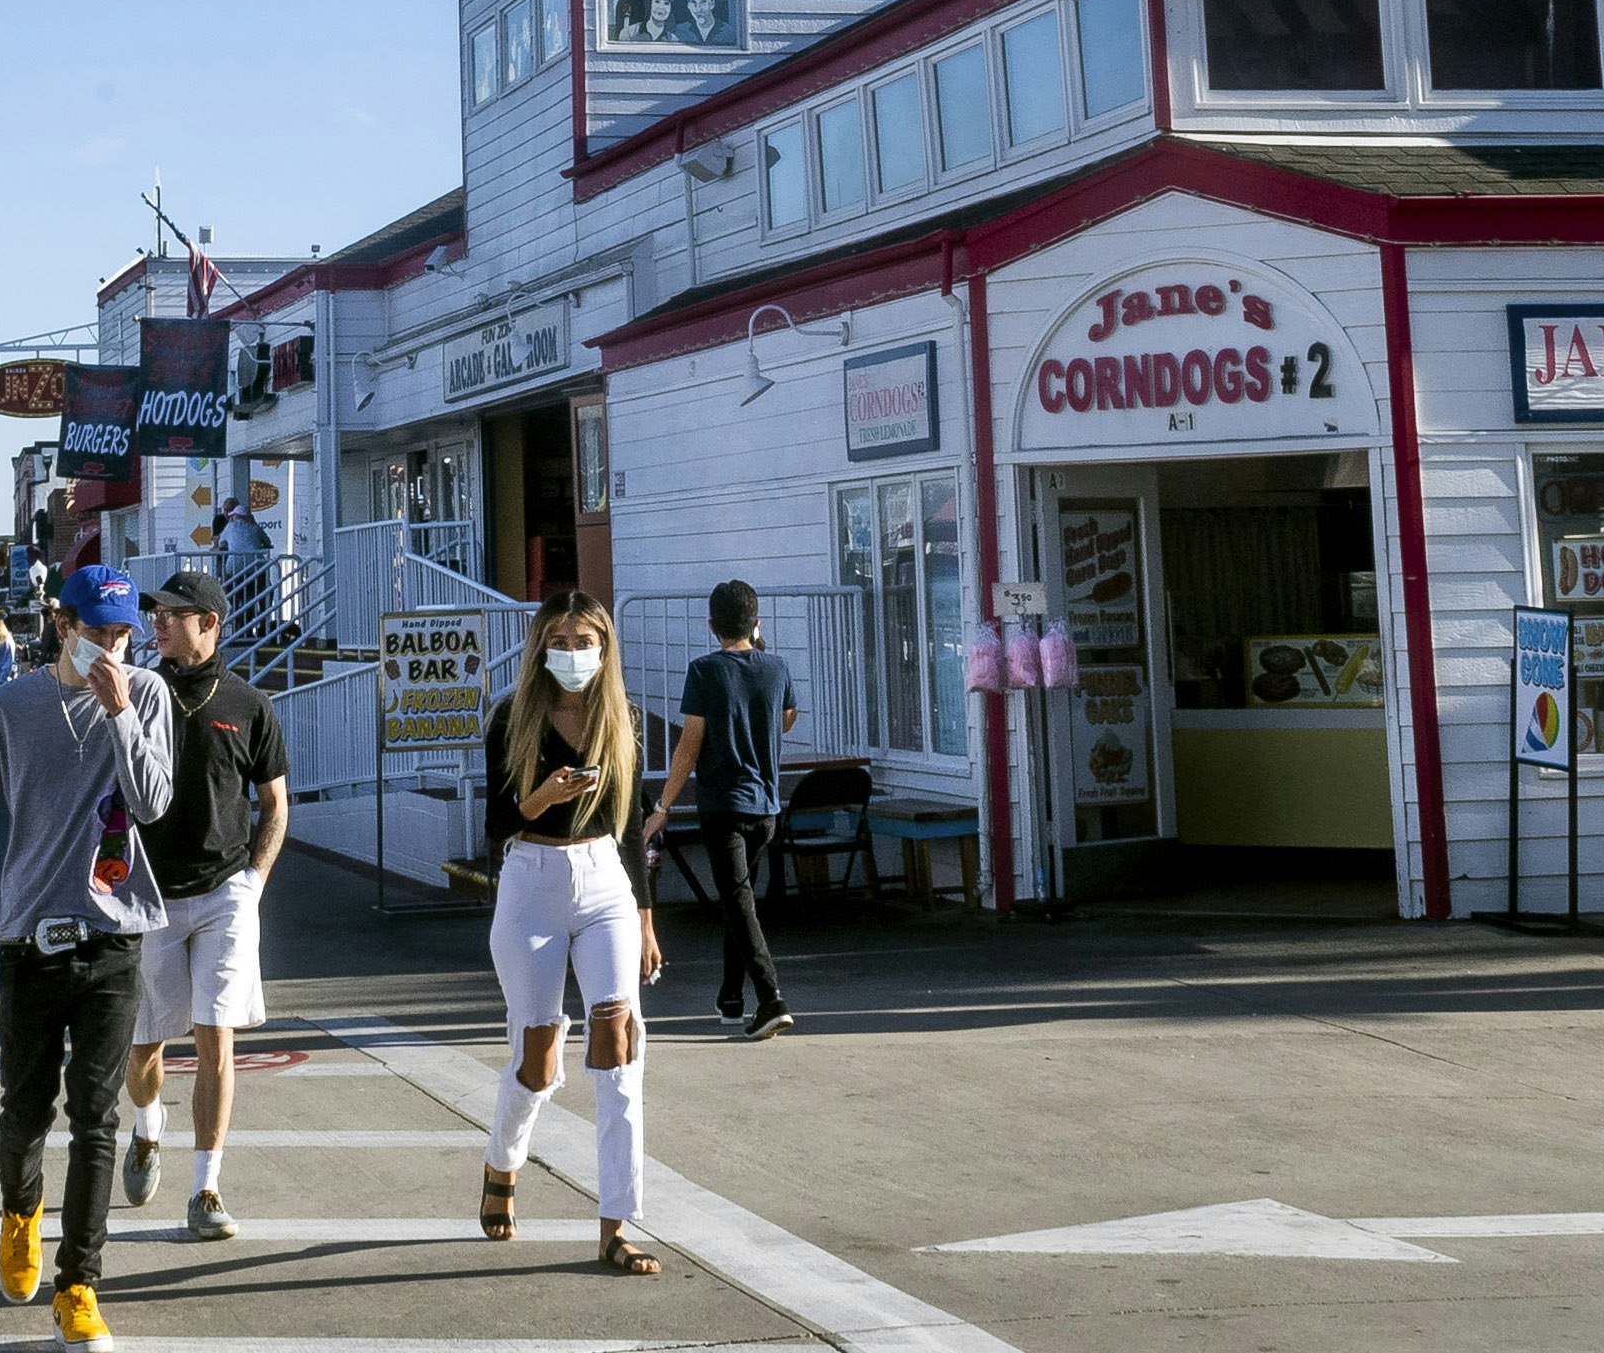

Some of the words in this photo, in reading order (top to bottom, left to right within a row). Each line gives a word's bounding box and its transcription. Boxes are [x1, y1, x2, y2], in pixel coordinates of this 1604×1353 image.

[1087, 279, 1277, 342] Jane's
[481, 327, 496, 346] FUN
[28, 364, 66, 409] ZO
[449, 349, 486, 394] ARCADE
[1038, 345, 1272, 414] CORNDOGS
[138, 390, 228, 428] HOTDOGS
[849, 383, 920, 423] CORNDOGS
[63, 421, 131, 457] BURGERS
[1168, 413, 1196, 431] A-1
[401, 619, 427, 629] Hand
[429, 618, 463, 629] Dipped
[1518, 616, 1569, 657] SNOW
[385, 630, 480, 656] BALBOA
[407, 658, 460, 684] BAR
[1520, 652, 1566, 690] CONE
[400, 687, 482, 715] FROZEN
[386, 714, 483, 743] BANANA
